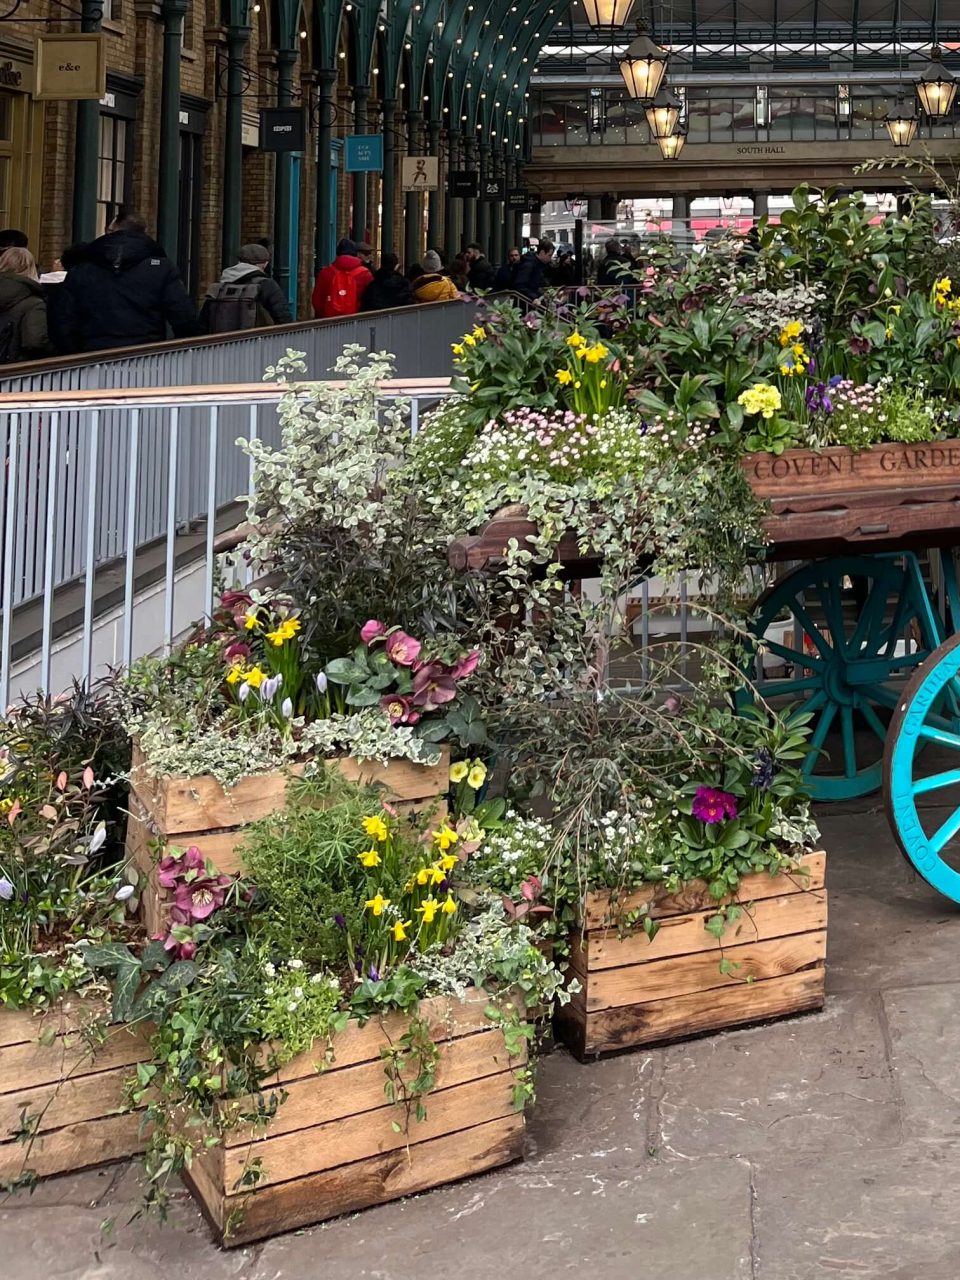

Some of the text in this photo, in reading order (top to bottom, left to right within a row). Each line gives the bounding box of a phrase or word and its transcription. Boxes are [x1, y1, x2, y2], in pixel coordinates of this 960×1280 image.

[59, 63, 81, 72] e&e
[737, 146, 785, 154] SOUTH HALL
[754, 454, 861, 480] COVENT
[895, 658, 958, 872] COVENT GARDEN
